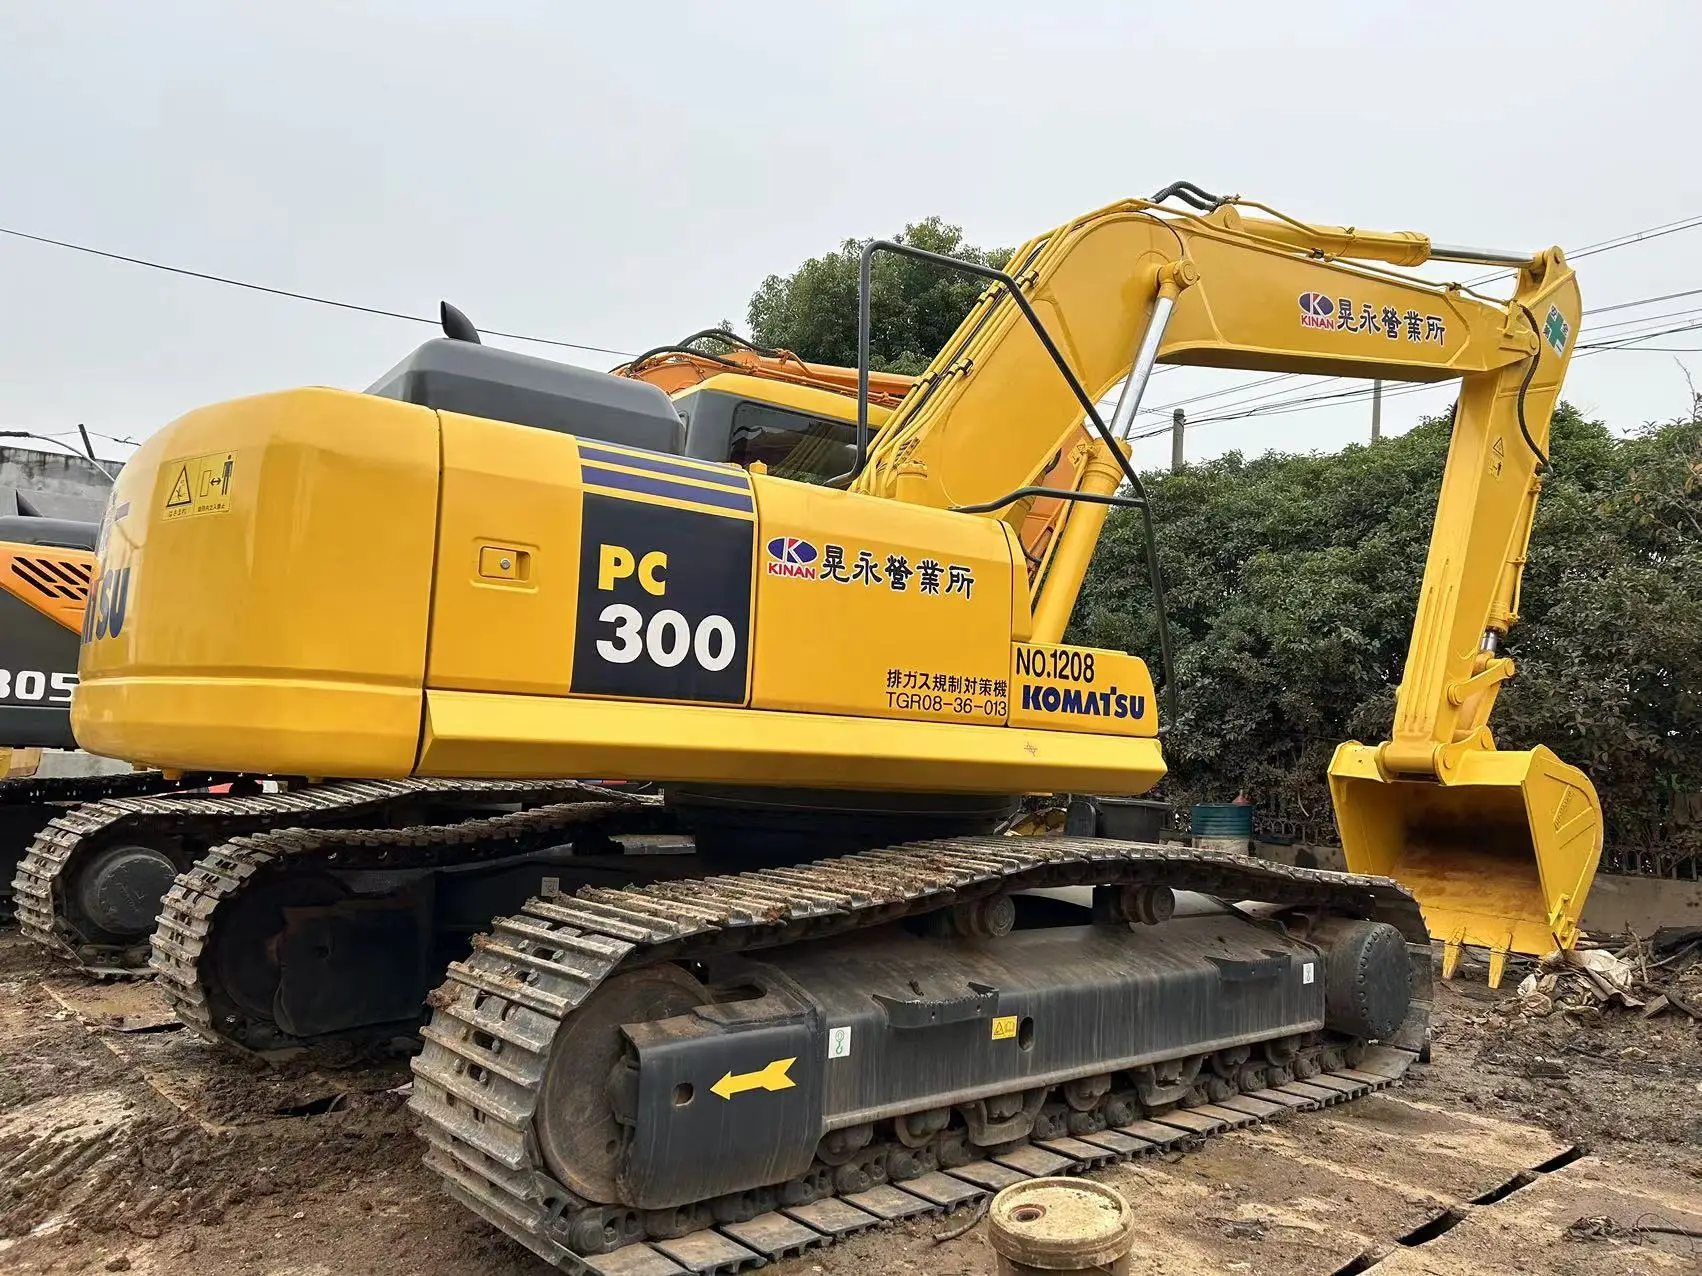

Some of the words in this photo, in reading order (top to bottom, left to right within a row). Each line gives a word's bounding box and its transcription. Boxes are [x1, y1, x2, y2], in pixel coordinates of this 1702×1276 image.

[1301, 314, 1334, 330] KINAN
[598, 543, 668, 596] PC
[768, 562, 816, 580] KINAN
[596, 603, 736, 672] 300
[1016, 647, 1095, 683] NO.1208
[886, 669, 1008, 698] 排ガス規制対策機
[886, 691, 1007, 717] TGR08-36-013
[1022, 684, 1145, 719] KOMATSU
